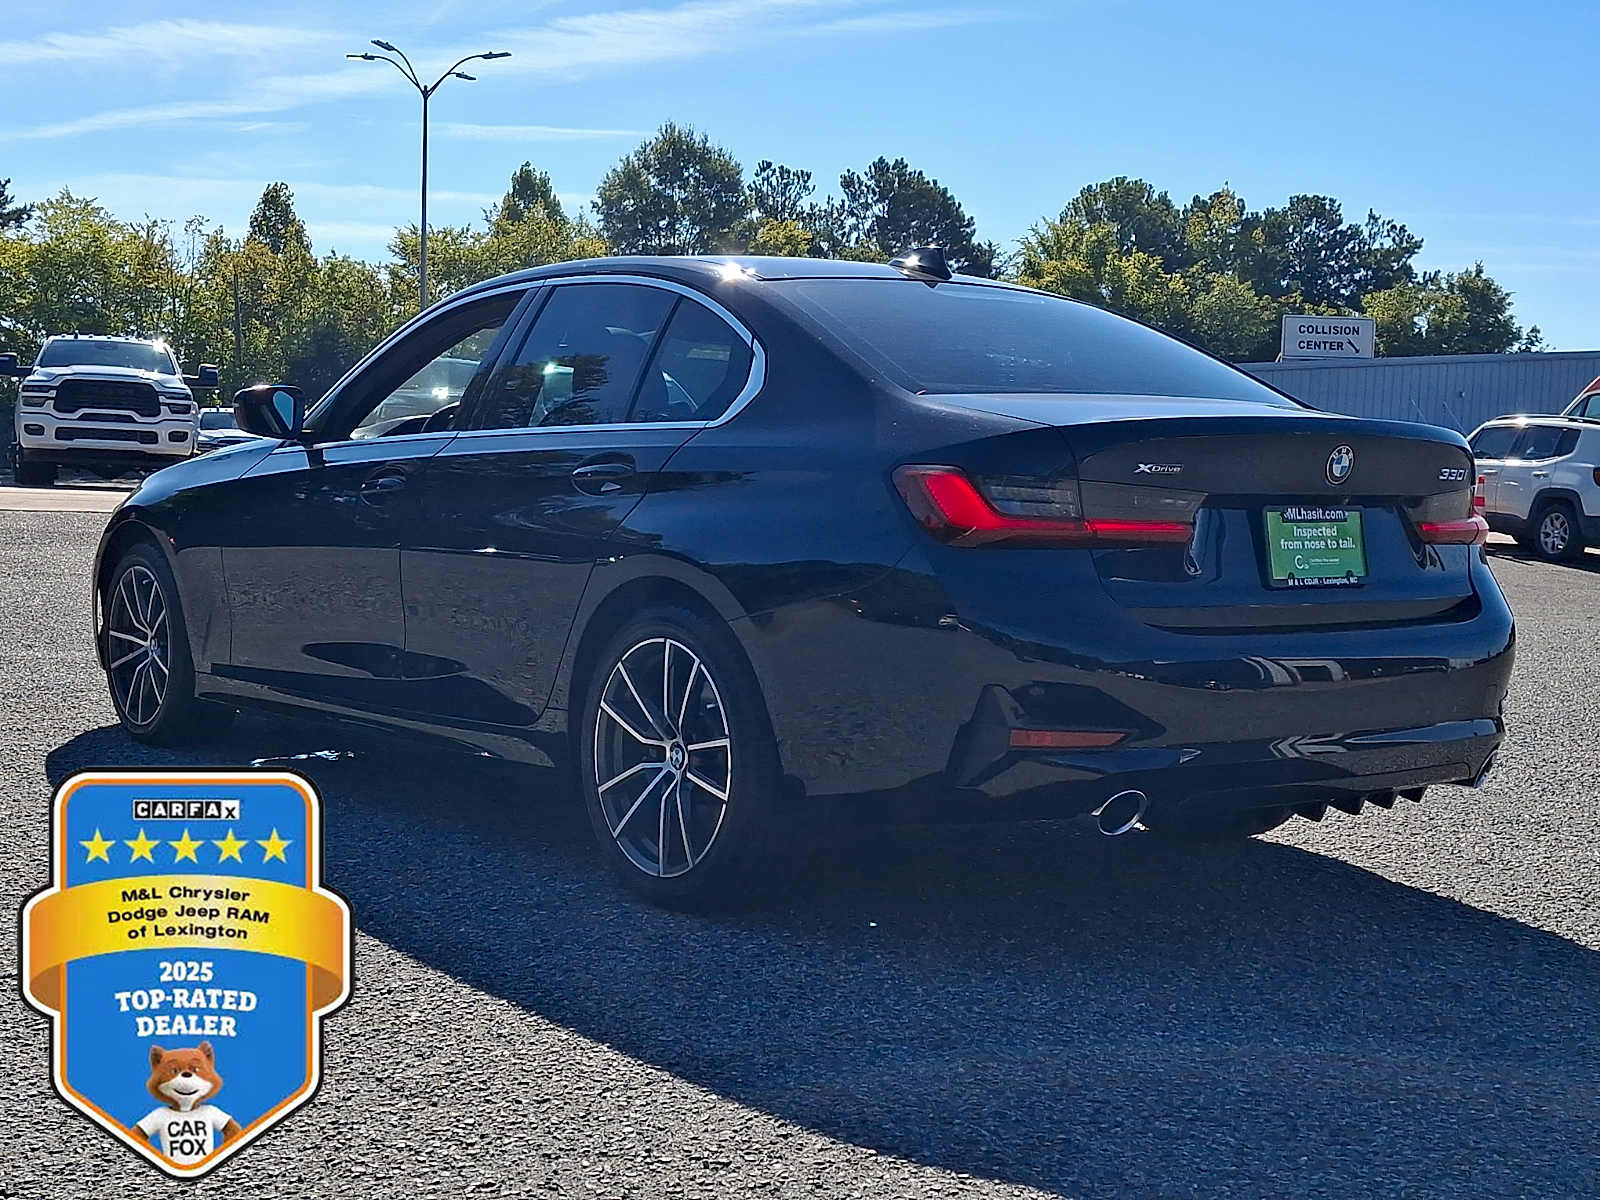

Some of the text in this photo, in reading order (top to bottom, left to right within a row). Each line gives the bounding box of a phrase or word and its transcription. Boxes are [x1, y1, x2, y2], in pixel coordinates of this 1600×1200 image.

[1298, 324, 1360, 336] COLLISION
[1298, 340, 1344, 351] CENTER
[1287, 507, 1344, 520] MLhasit.com
[1293, 525, 1337, 539] Inspected
[1280, 537, 1356, 549] from nose to tail.
